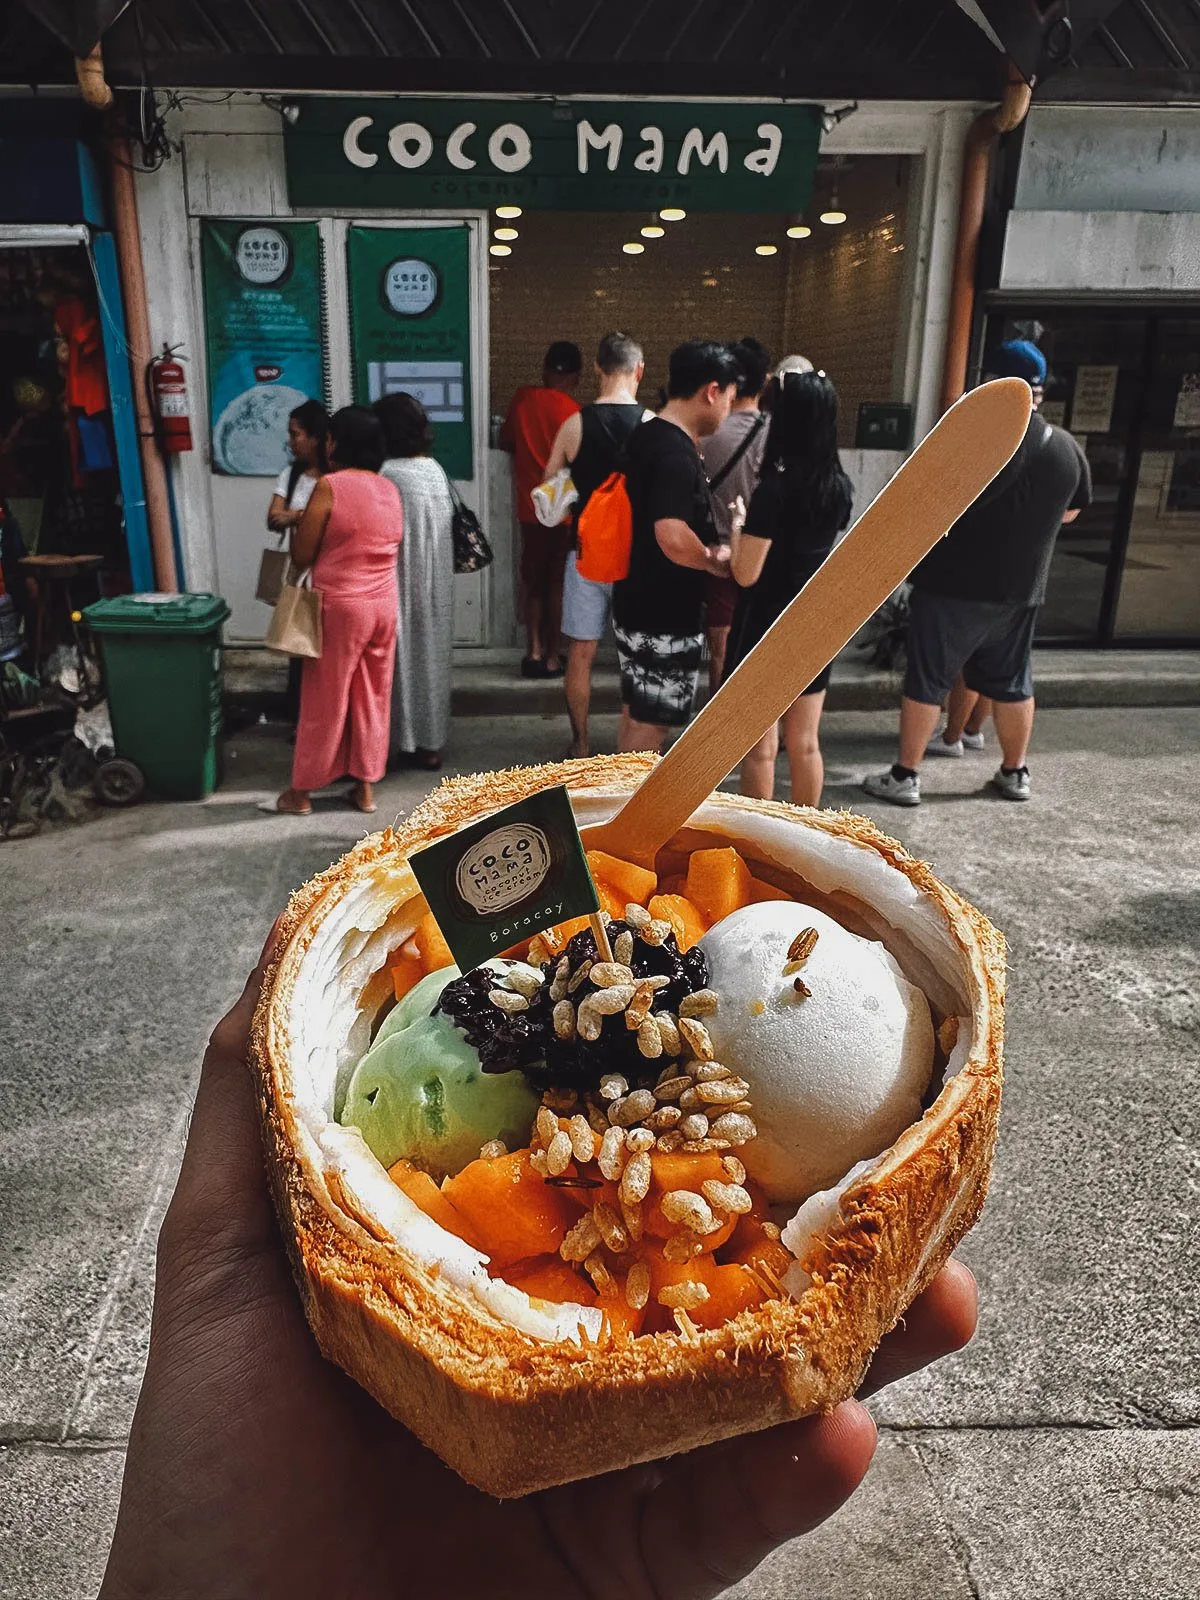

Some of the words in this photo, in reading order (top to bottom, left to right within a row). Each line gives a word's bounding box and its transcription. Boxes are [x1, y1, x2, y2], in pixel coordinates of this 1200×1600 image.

[343, 116, 532, 173] COCO
[468, 838, 531, 876] COCO
[482, 890, 501, 903] ice
[506, 871, 541, 891] cream
[485, 867, 530, 895] coconut
[489, 902, 564, 943] Boracay
